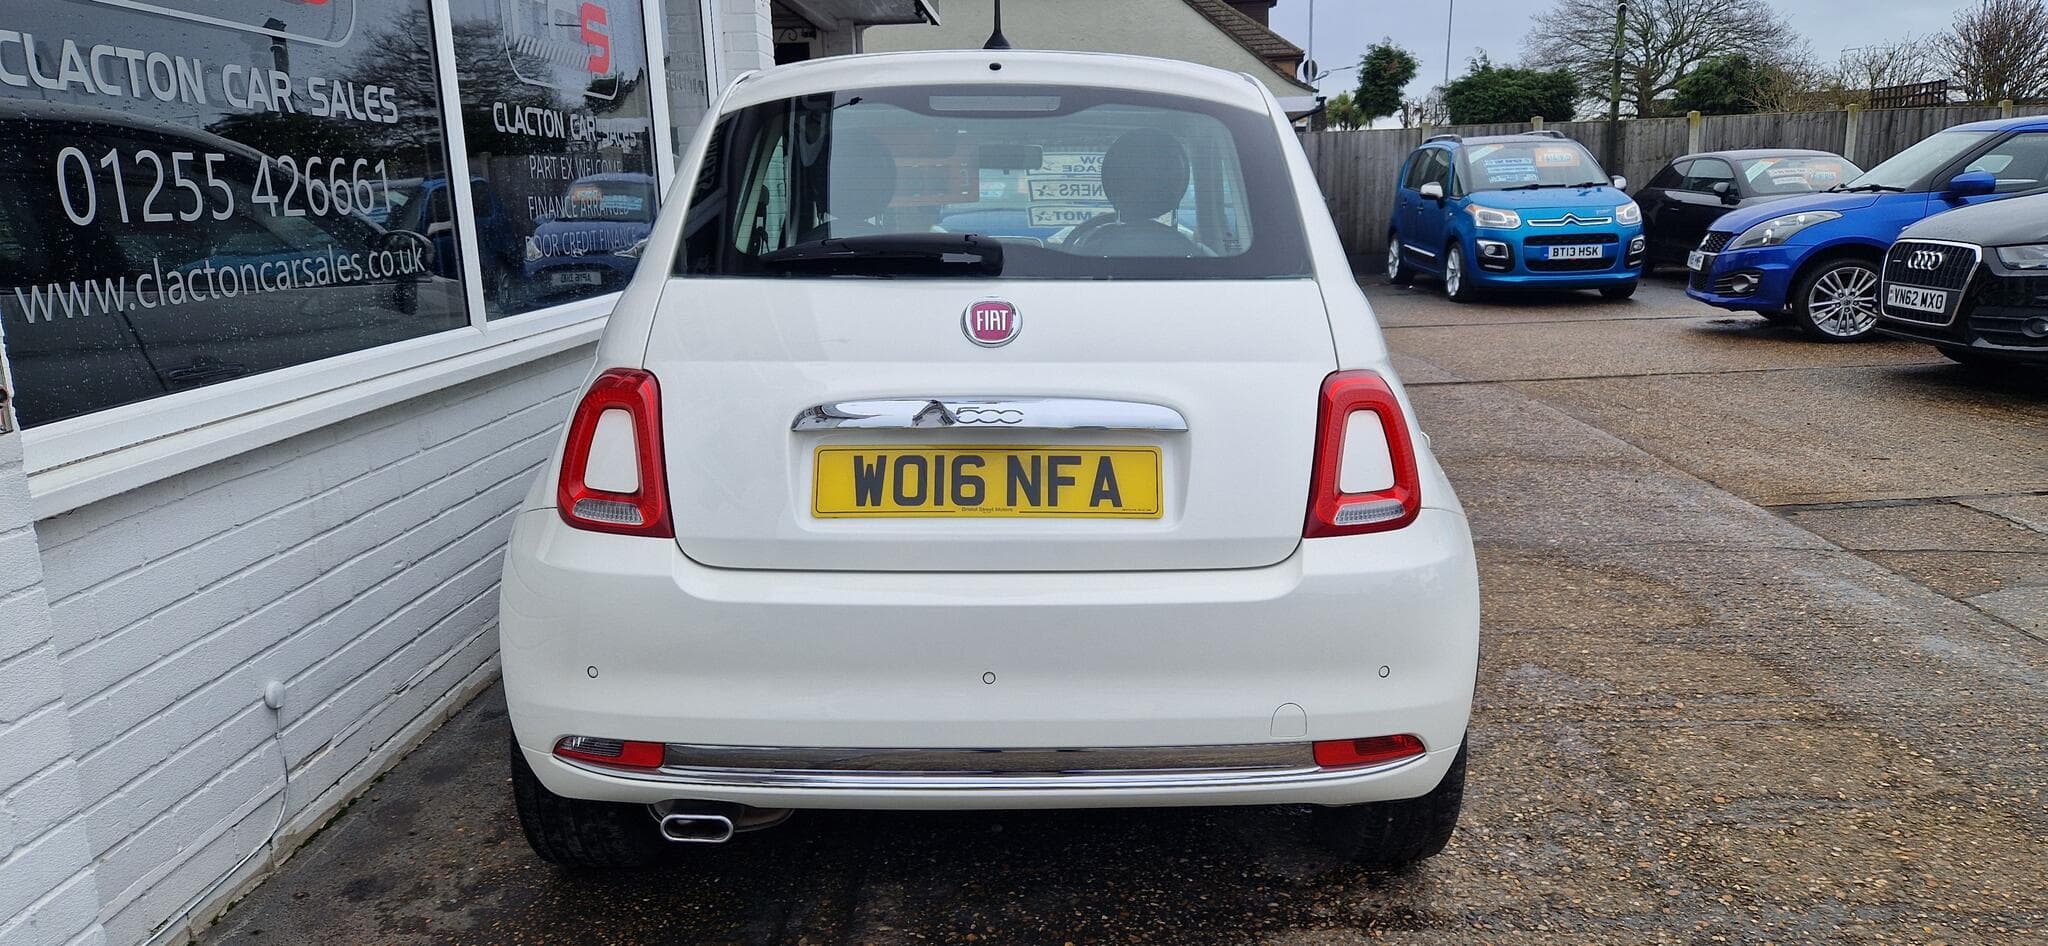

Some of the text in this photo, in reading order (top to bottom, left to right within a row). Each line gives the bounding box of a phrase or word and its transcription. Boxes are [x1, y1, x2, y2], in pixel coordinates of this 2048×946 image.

[0, 29, 399, 125] CLACTON CAR SALES
[493, 102, 566, 139] CLACTON
[570, 113, 598, 142] CAR
[529, 155, 623, 180] PART EX WELCOME
[56, 146, 392, 227] 01255 426661
[528, 195, 578, 220] FINANCE
[562, 230, 597, 256] CREDIT
[599, 226, 636, 251] FINANCE
[1552, 246, 1599, 258] BT13 HSK
[15, 243, 426, 325] www.clactoncarsales.co.uk
[1893, 285, 1944, 311] VN62 MXO
[976, 309, 1009, 331] FIAT
[853, 454, 1123, 507] WO16 NFA
